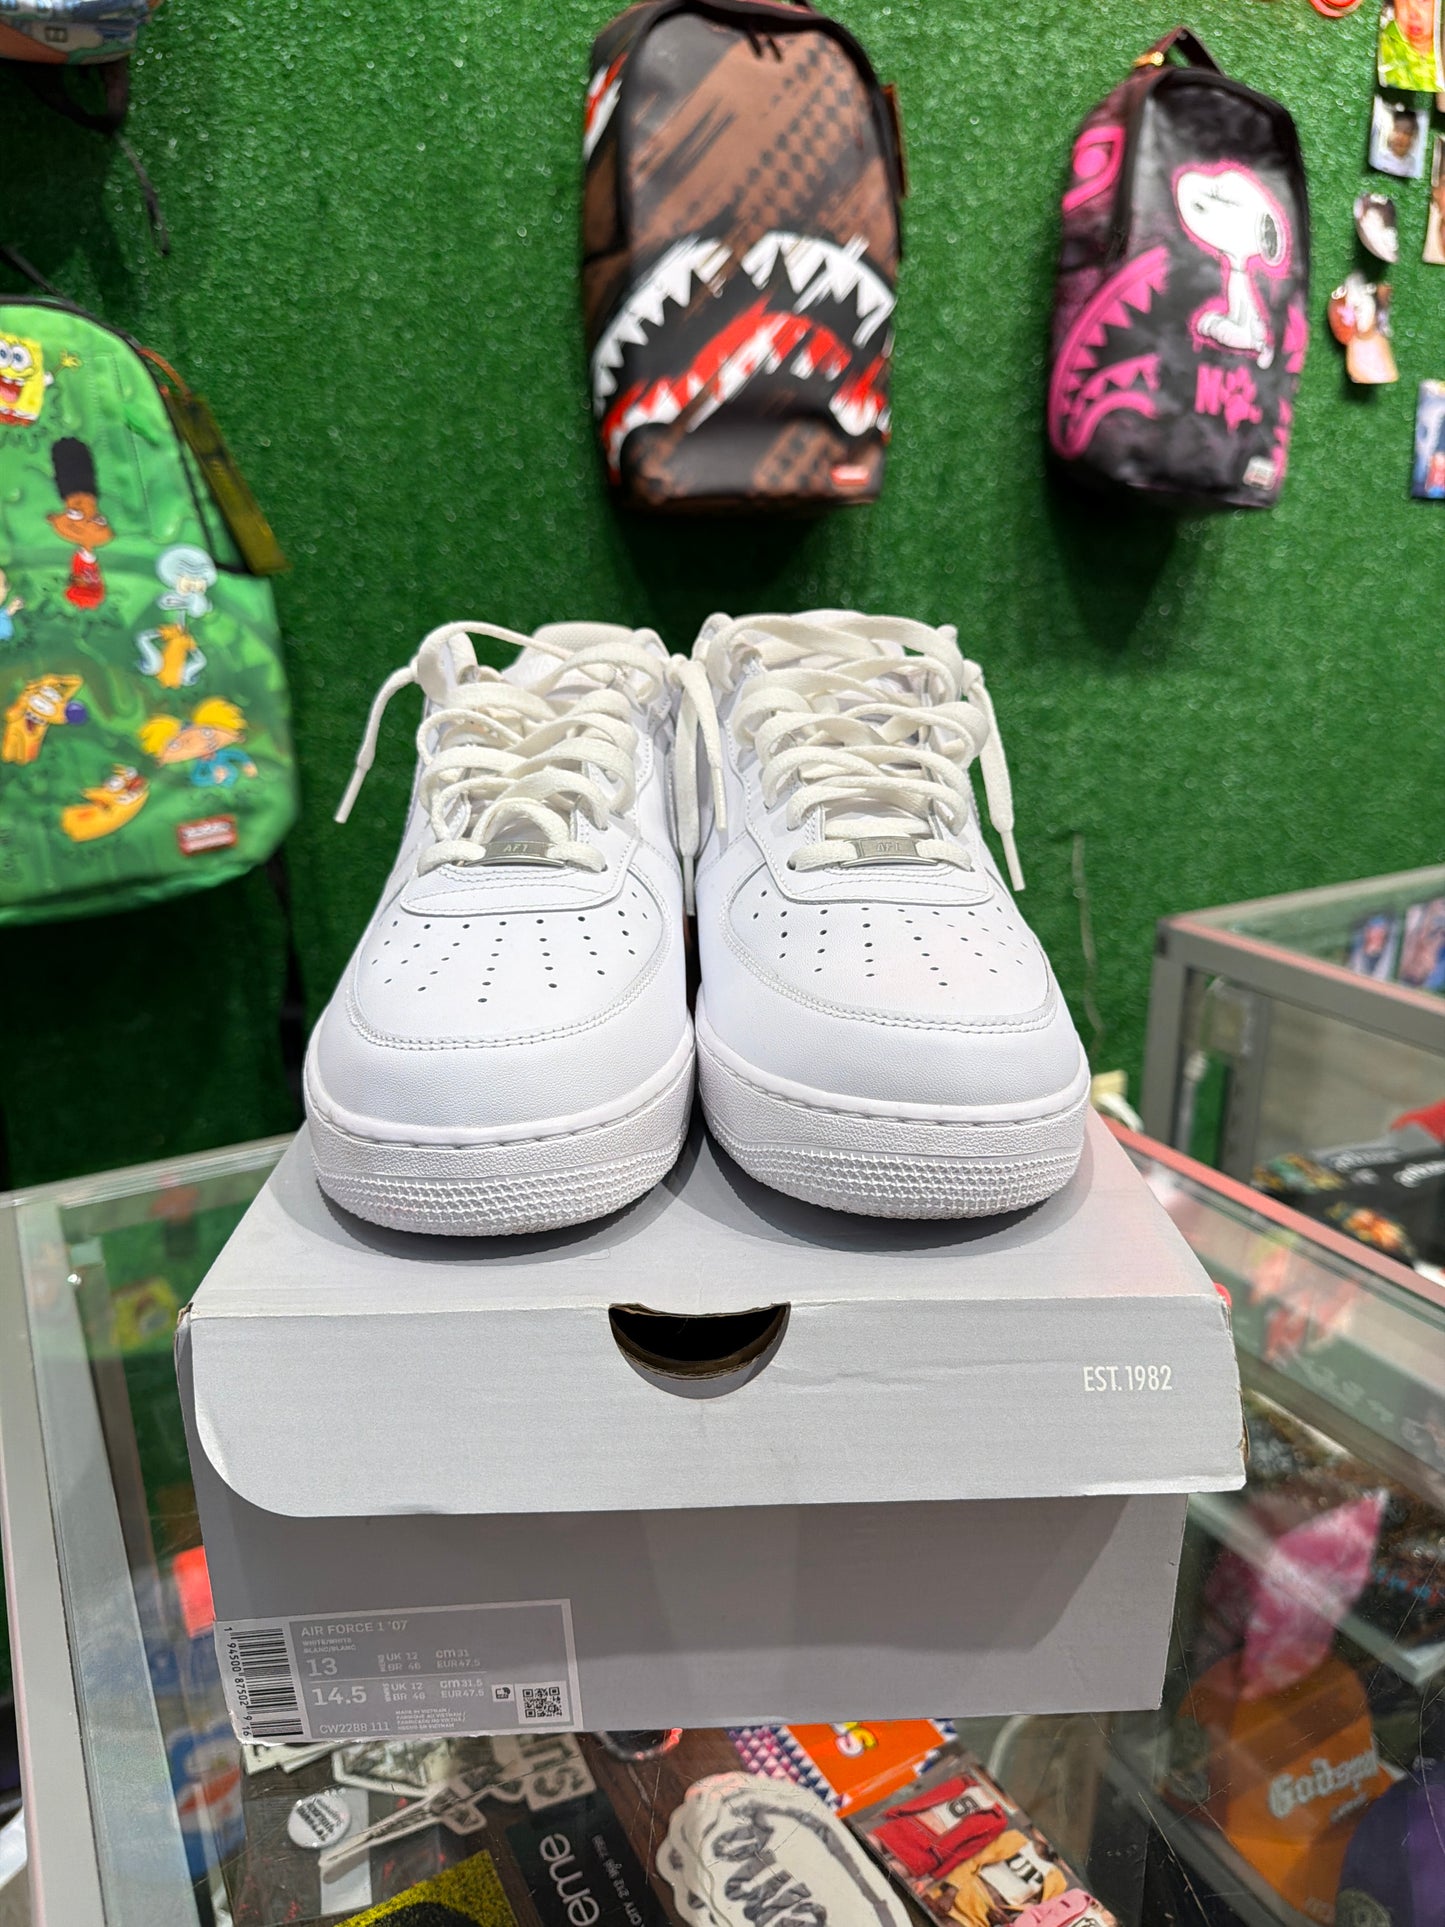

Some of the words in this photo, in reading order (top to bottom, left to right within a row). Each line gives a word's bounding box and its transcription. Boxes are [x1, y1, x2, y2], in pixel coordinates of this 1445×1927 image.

[503, 843, 529, 853] AF1
[301, 1623, 324, 1637] AIR
[327, 1621, 374, 1635] FORCE
[377, 1621, 384, 1631] 1
[386, 1652, 402, 1662] UK
[405, 1651, 418, 1661] 12
[226, 1642, 241, 1673] 94500
[234, 1677, 249, 1706] 87502
[306, 1657, 338, 1677] 13
[390, 1682, 407, 1691] UK
[410, 1681, 424, 1690] 12
[311, 1685, 367, 1706] 14.5
[319, 1722, 368, 1734] CW2288
[371, 1721, 390, 1731] 111
